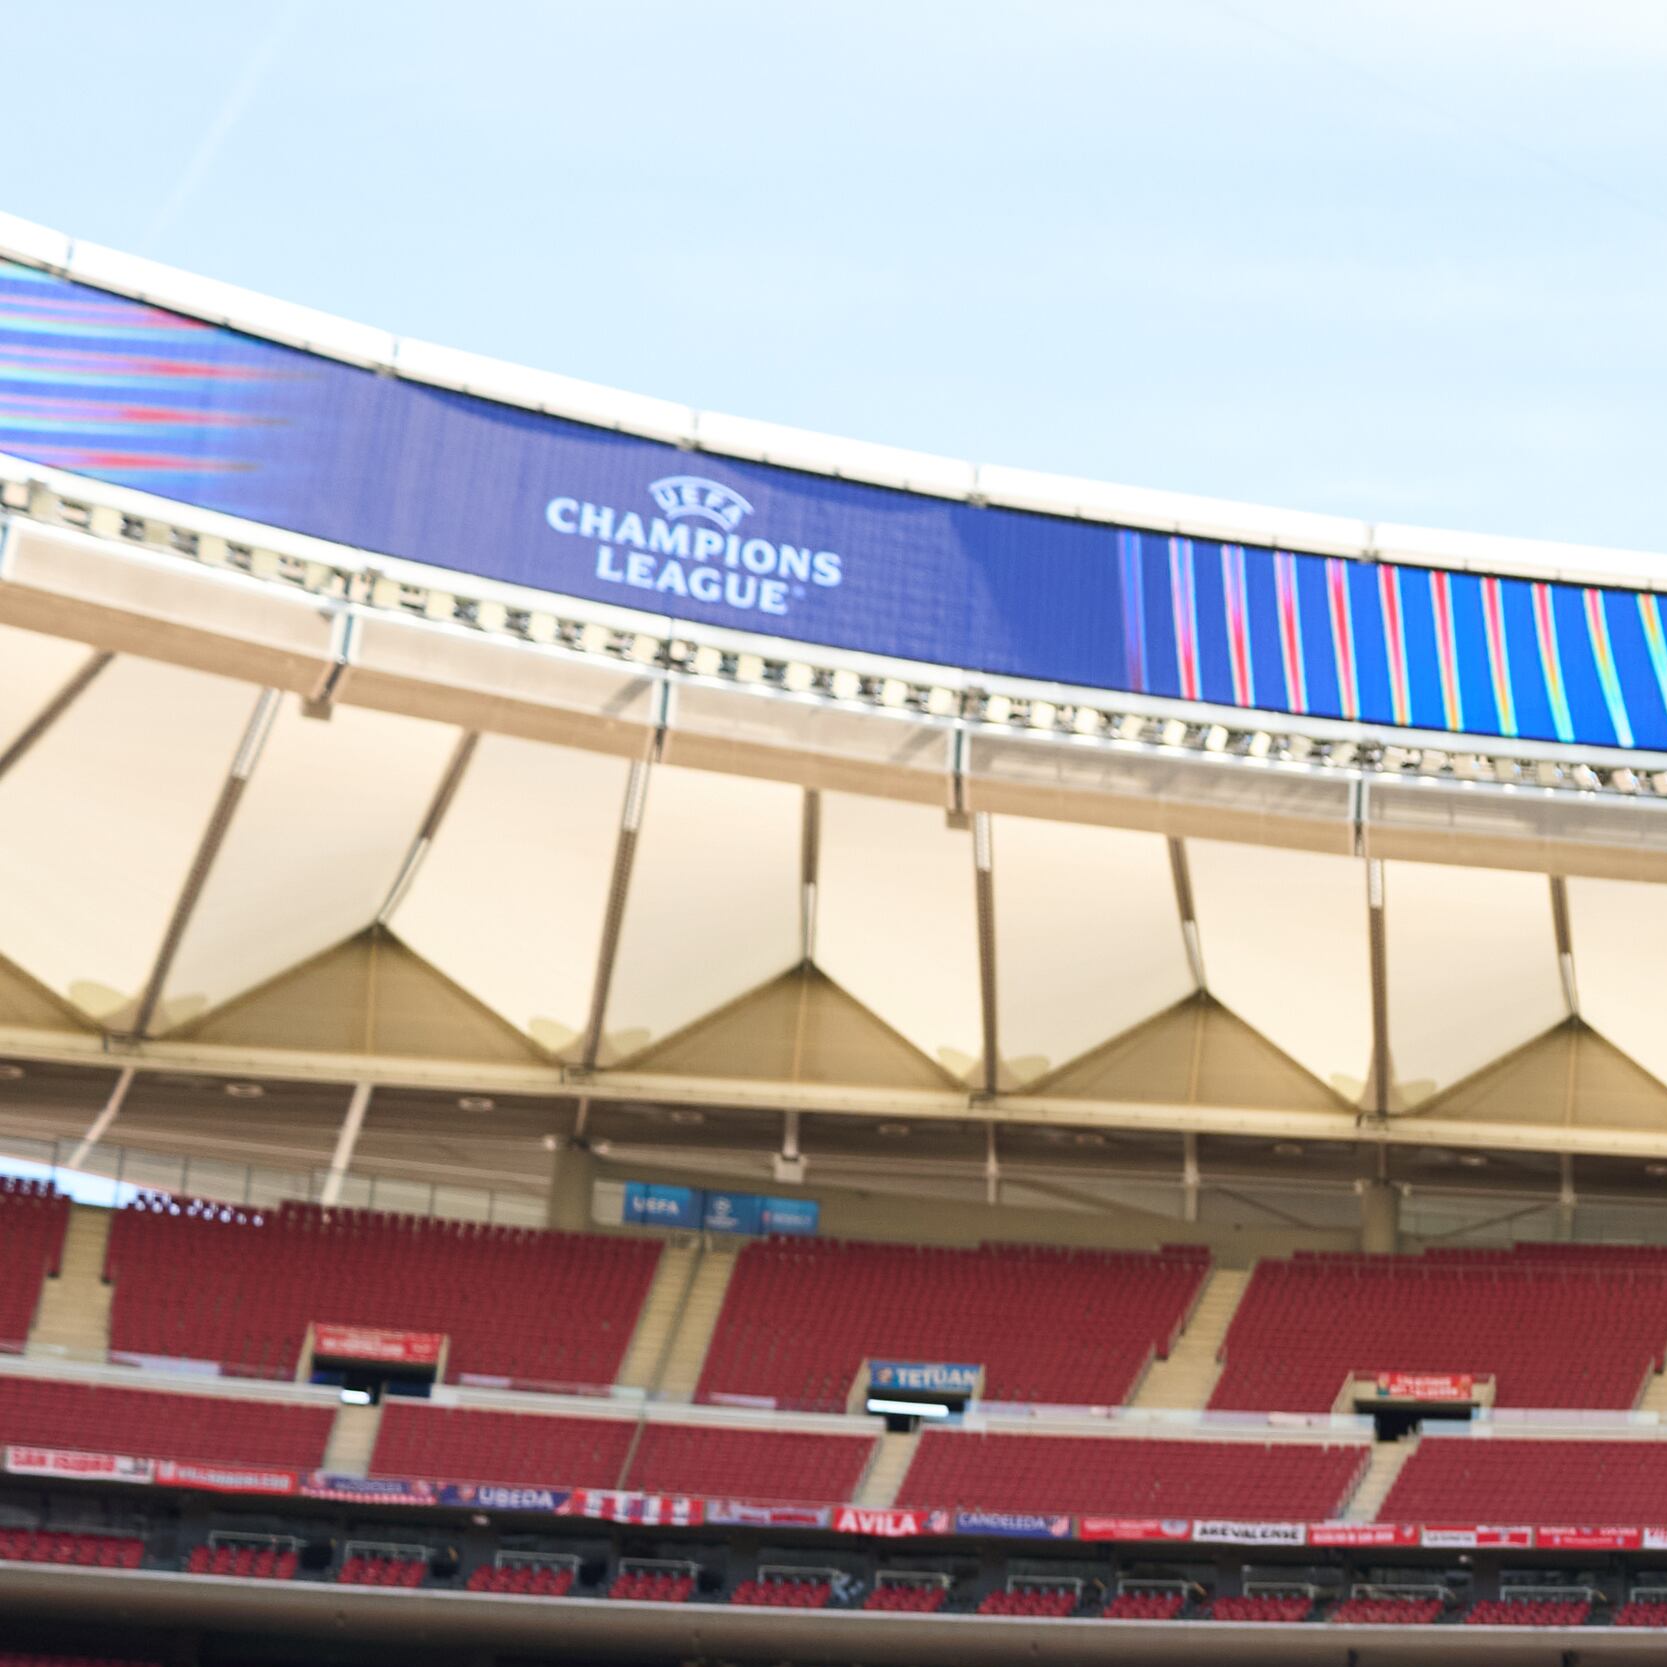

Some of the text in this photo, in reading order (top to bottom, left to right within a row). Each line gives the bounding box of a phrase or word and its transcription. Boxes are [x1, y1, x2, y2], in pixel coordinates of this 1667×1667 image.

[650, 482, 745, 528] UEFA
[546, 496, 843, 587] CHAMPIONS
[596, 544, 789, 616] LEAGUE
